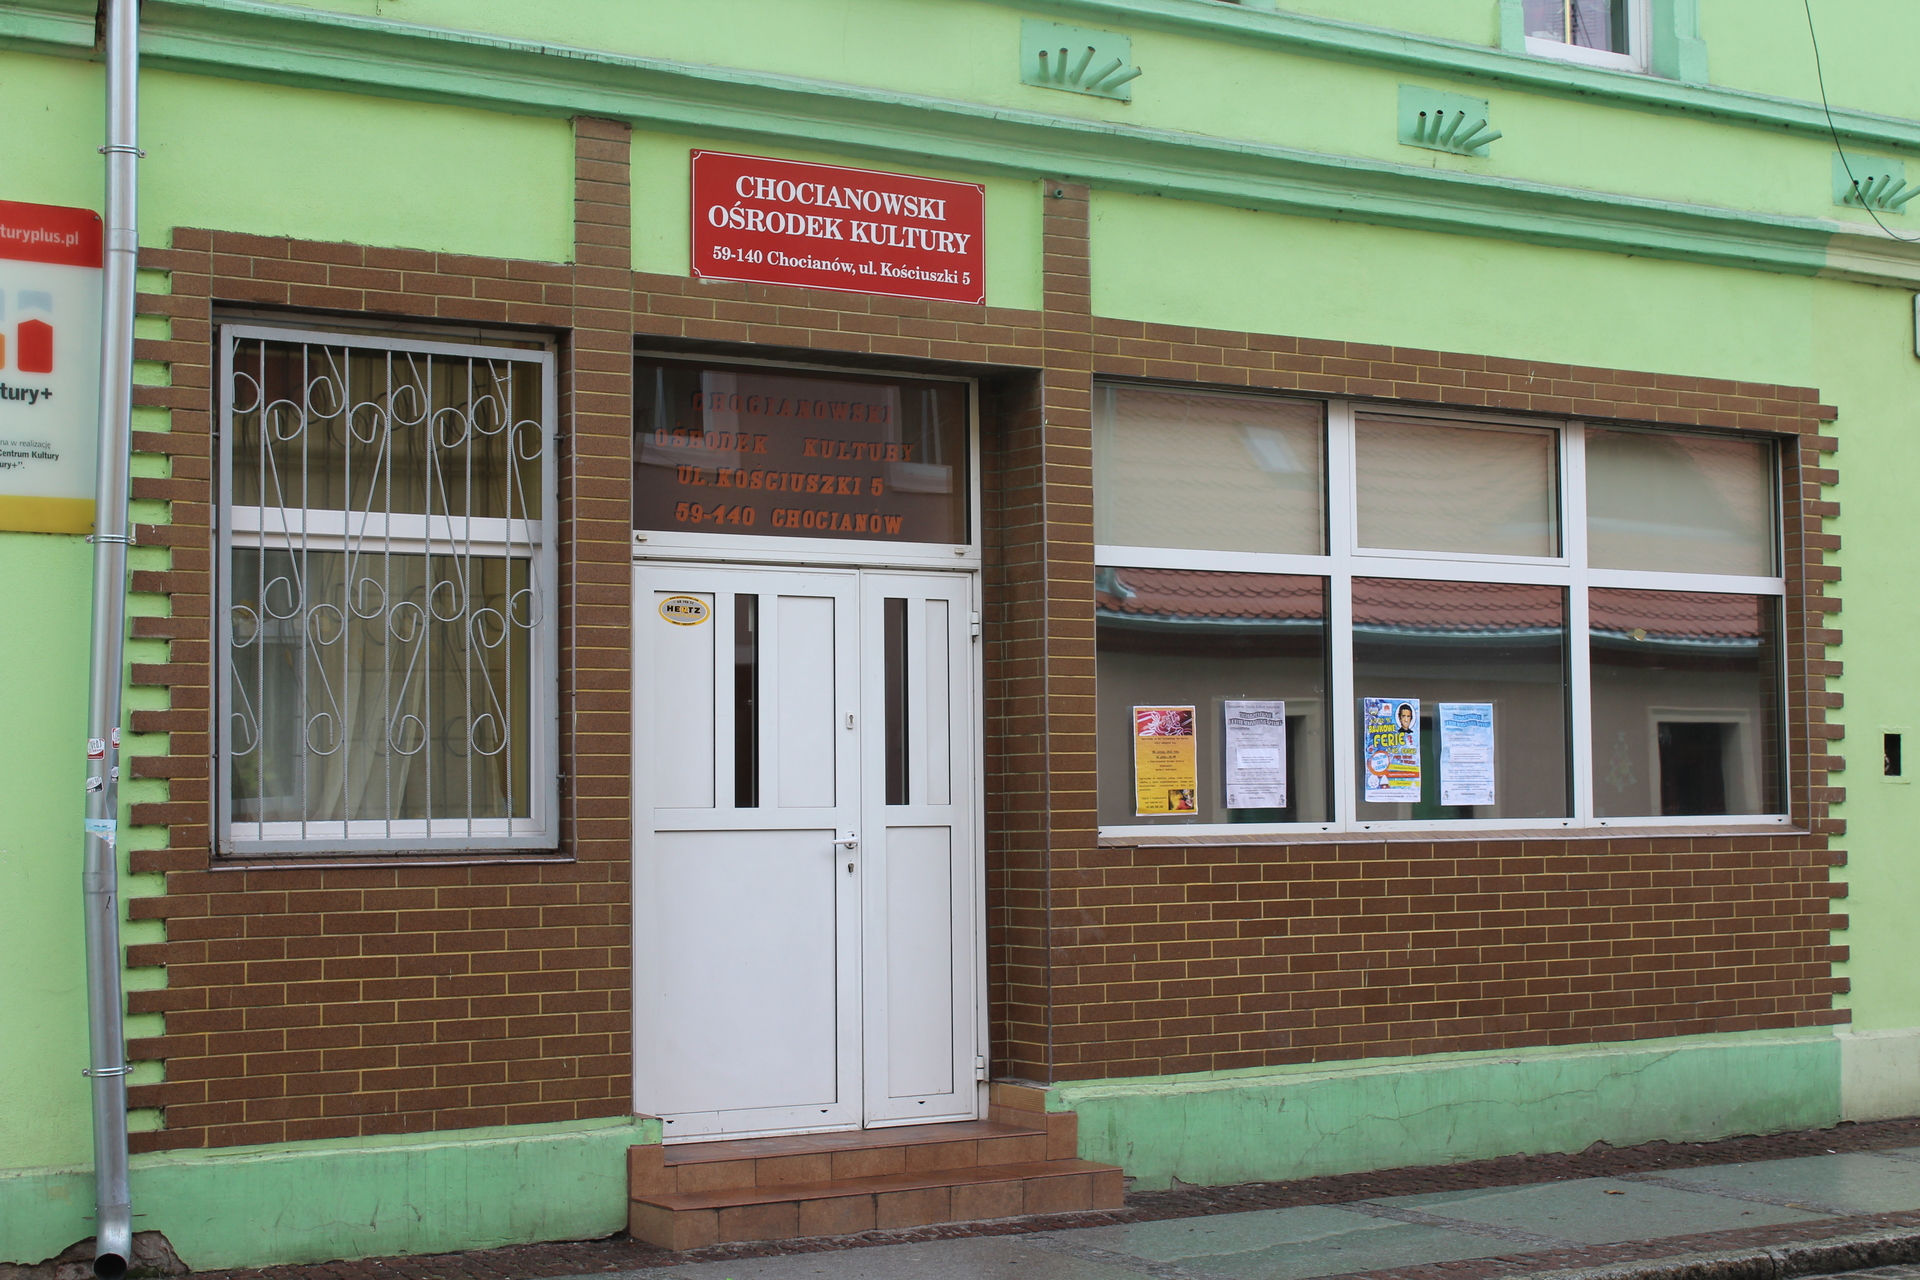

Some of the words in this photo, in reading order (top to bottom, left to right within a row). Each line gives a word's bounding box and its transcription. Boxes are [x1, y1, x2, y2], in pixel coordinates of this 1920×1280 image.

[735, 175, 946, 221] CHOCIANOWSKI
[0, 224, 79, 247] turyplus.pl
[708, 201, 844, 240] OŚRODEK
[849, 220, 971, 255] KULTURY
[712, 245, 763, 264] 59-140
[767, 250, 856, 276] Chocianów,
[859, 261, 877, 275] ul.
[880, 262, 959, 284] Kościuszki
[962, 272, 971, 285] 5
[0, 383, 53, 405] tury+
[691, 391, 893, 424] CHOCIANOWSKI
[31, 451, 59, 461] Kultury
[654, 422, 769, 454] OŚRODEK
[803, 436, 915, 462] KULTURY
[870, 477, 884, 496] 5
[675, 502, 756, 526] 59-140
[771, 509, 904, 535] CHOCIANÓW
[667, 605, 700, 614] HERTZ
[1373, 732, 1406, 748] FERIE
